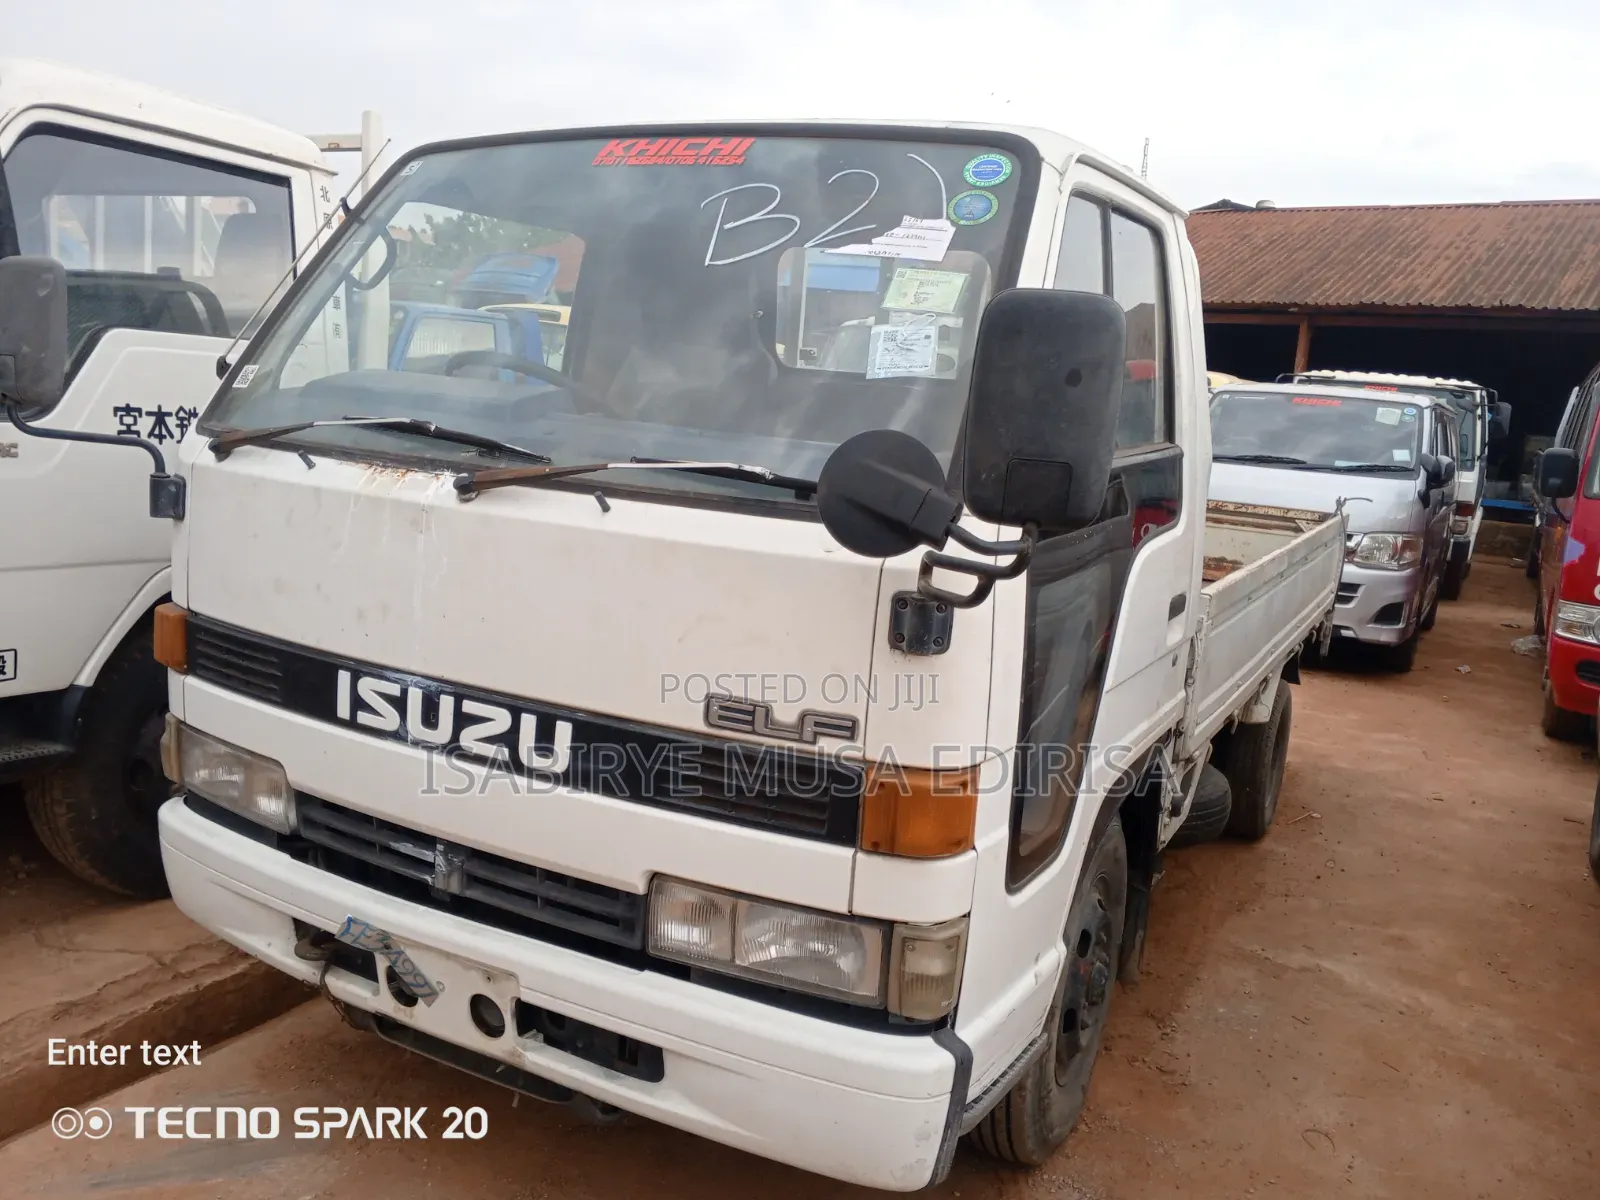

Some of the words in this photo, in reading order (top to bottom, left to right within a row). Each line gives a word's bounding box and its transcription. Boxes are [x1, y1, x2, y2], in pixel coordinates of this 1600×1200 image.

[598, 137, 757, 157] KHICHI
[337, 669, 573, 774] ISUZU
[704, 692, 859, 744] ELF
